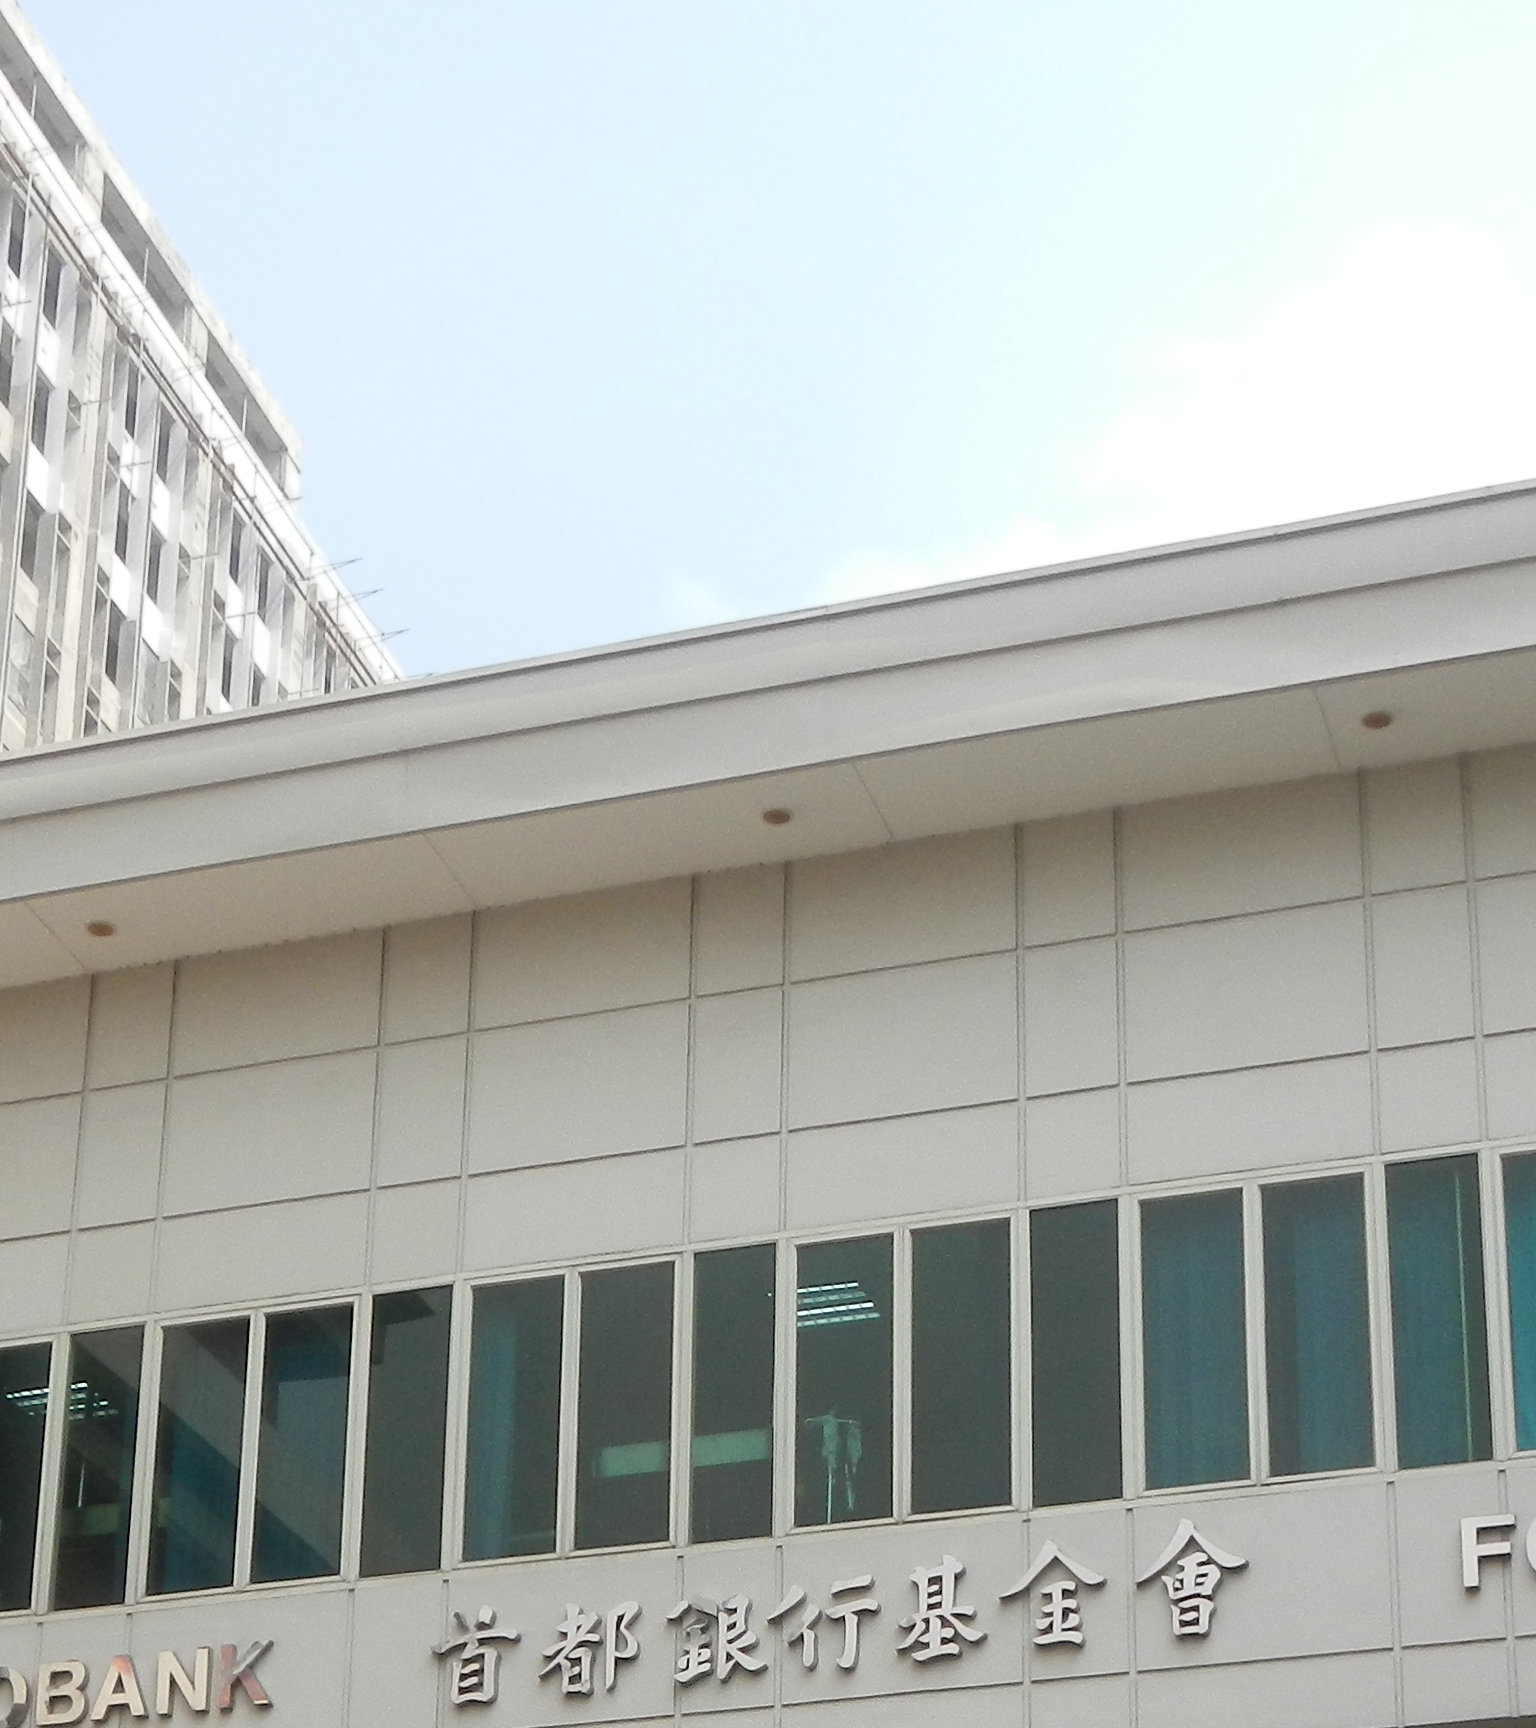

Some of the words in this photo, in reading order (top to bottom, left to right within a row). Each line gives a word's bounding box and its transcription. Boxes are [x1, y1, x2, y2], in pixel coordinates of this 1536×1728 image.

[432, 1518, 1249, 1706] 首都銀行基金會
